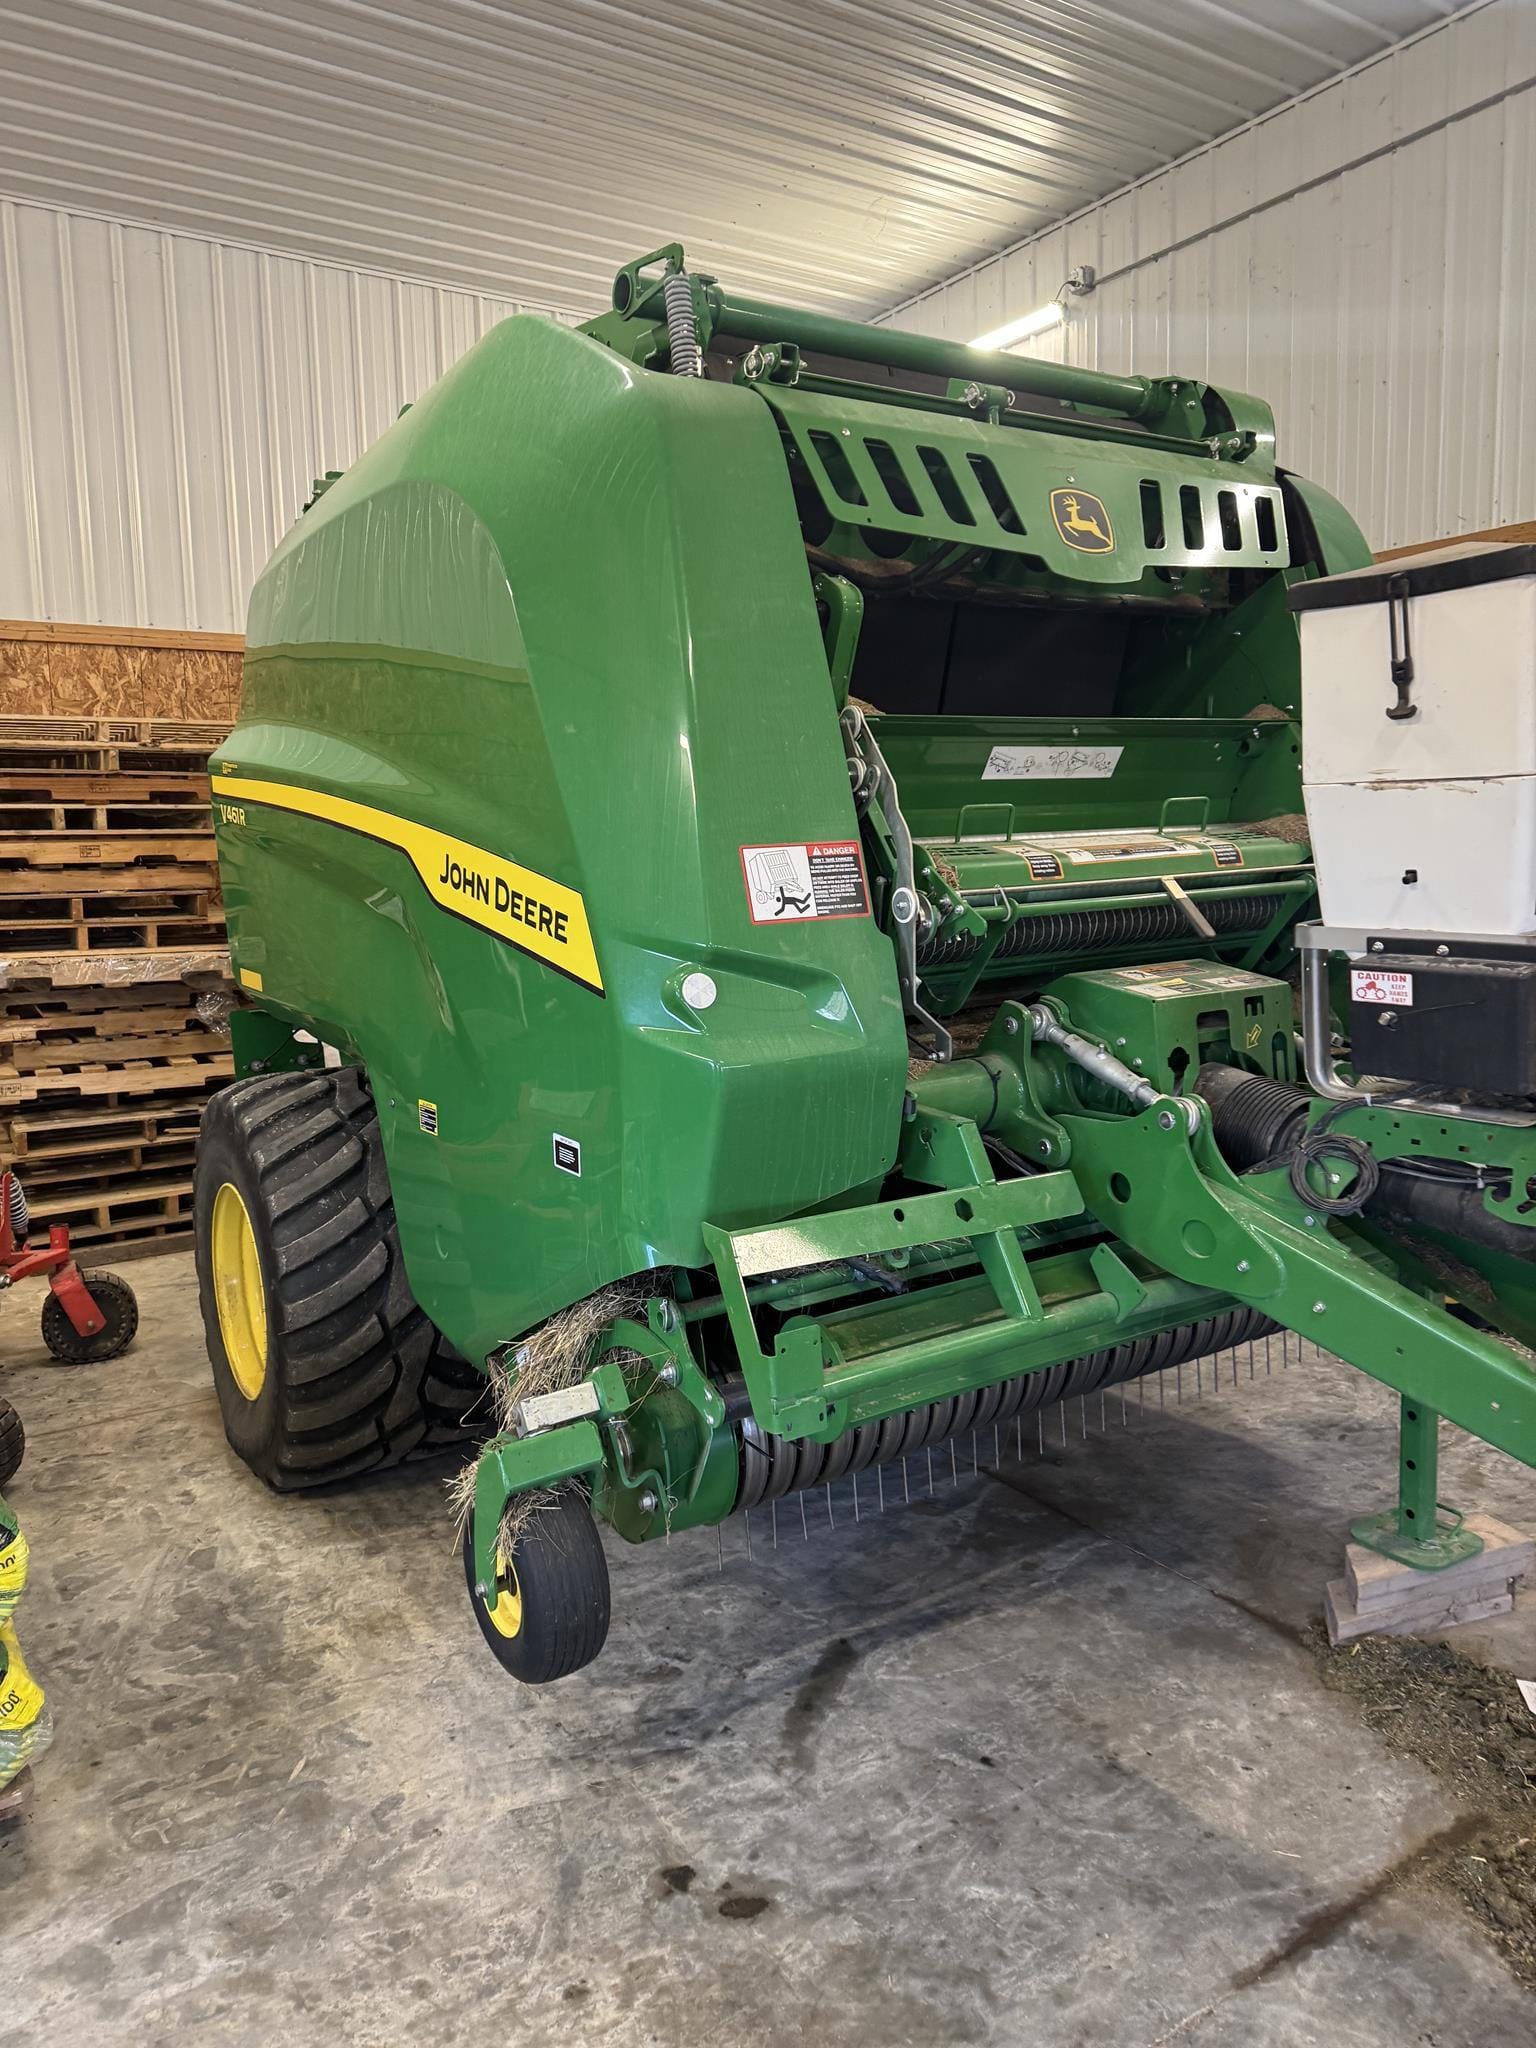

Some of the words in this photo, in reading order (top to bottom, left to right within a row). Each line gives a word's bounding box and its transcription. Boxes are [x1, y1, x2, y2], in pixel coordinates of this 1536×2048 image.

[220, 803, 247, 827] V461R
[823, 847, 855, 855] DANGER
[439, 853, 490, 906] JOHN
[494, 875, 570, 944] DEERE
[1357, 972, 1407, 983] CAUTION
